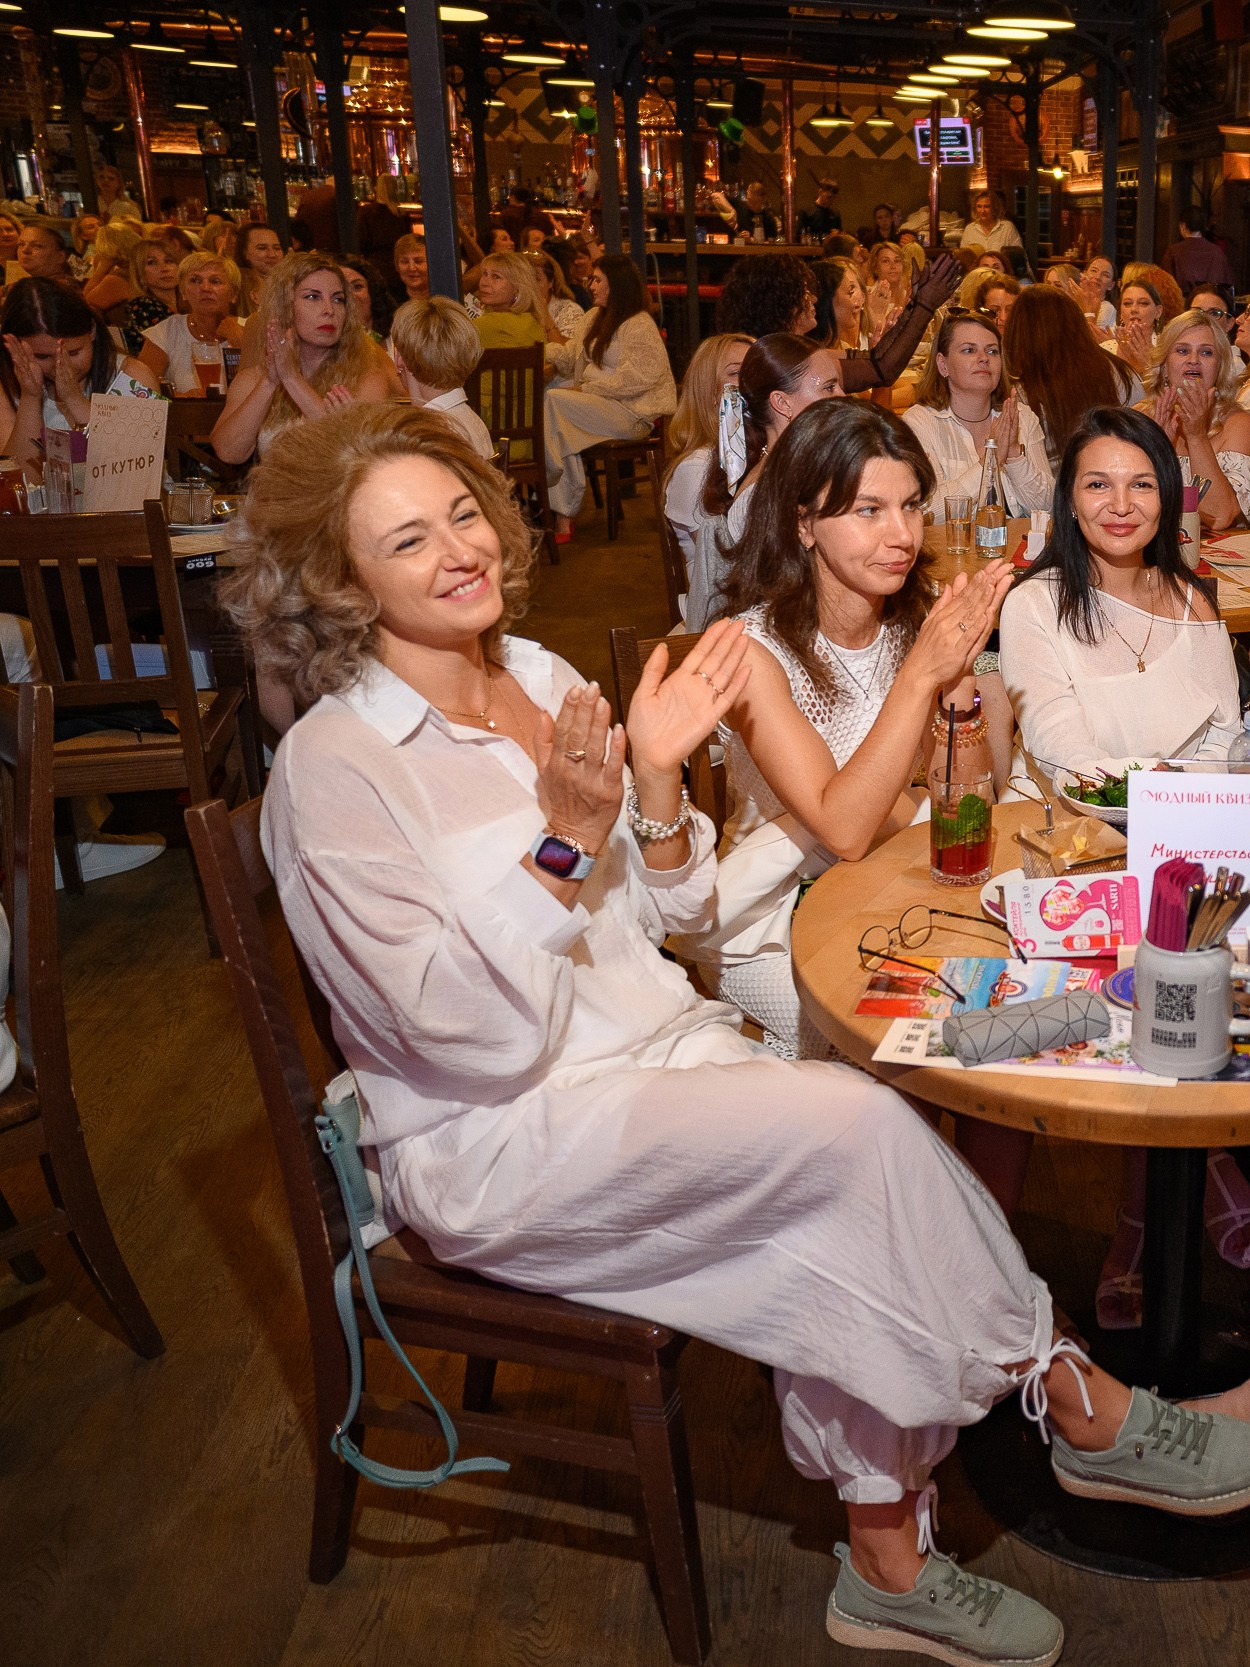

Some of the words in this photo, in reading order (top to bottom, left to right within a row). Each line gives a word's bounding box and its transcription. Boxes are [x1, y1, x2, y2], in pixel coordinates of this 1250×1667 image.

[91, 464, 108, 479] ОТ
[111, 454, 156, 476] КУТЮР
[185, 561, 215, 570] 600
[1140, 789, 1211, 805] МОДНЫЙ
[1109, 883, 1120, 911] SARTI
